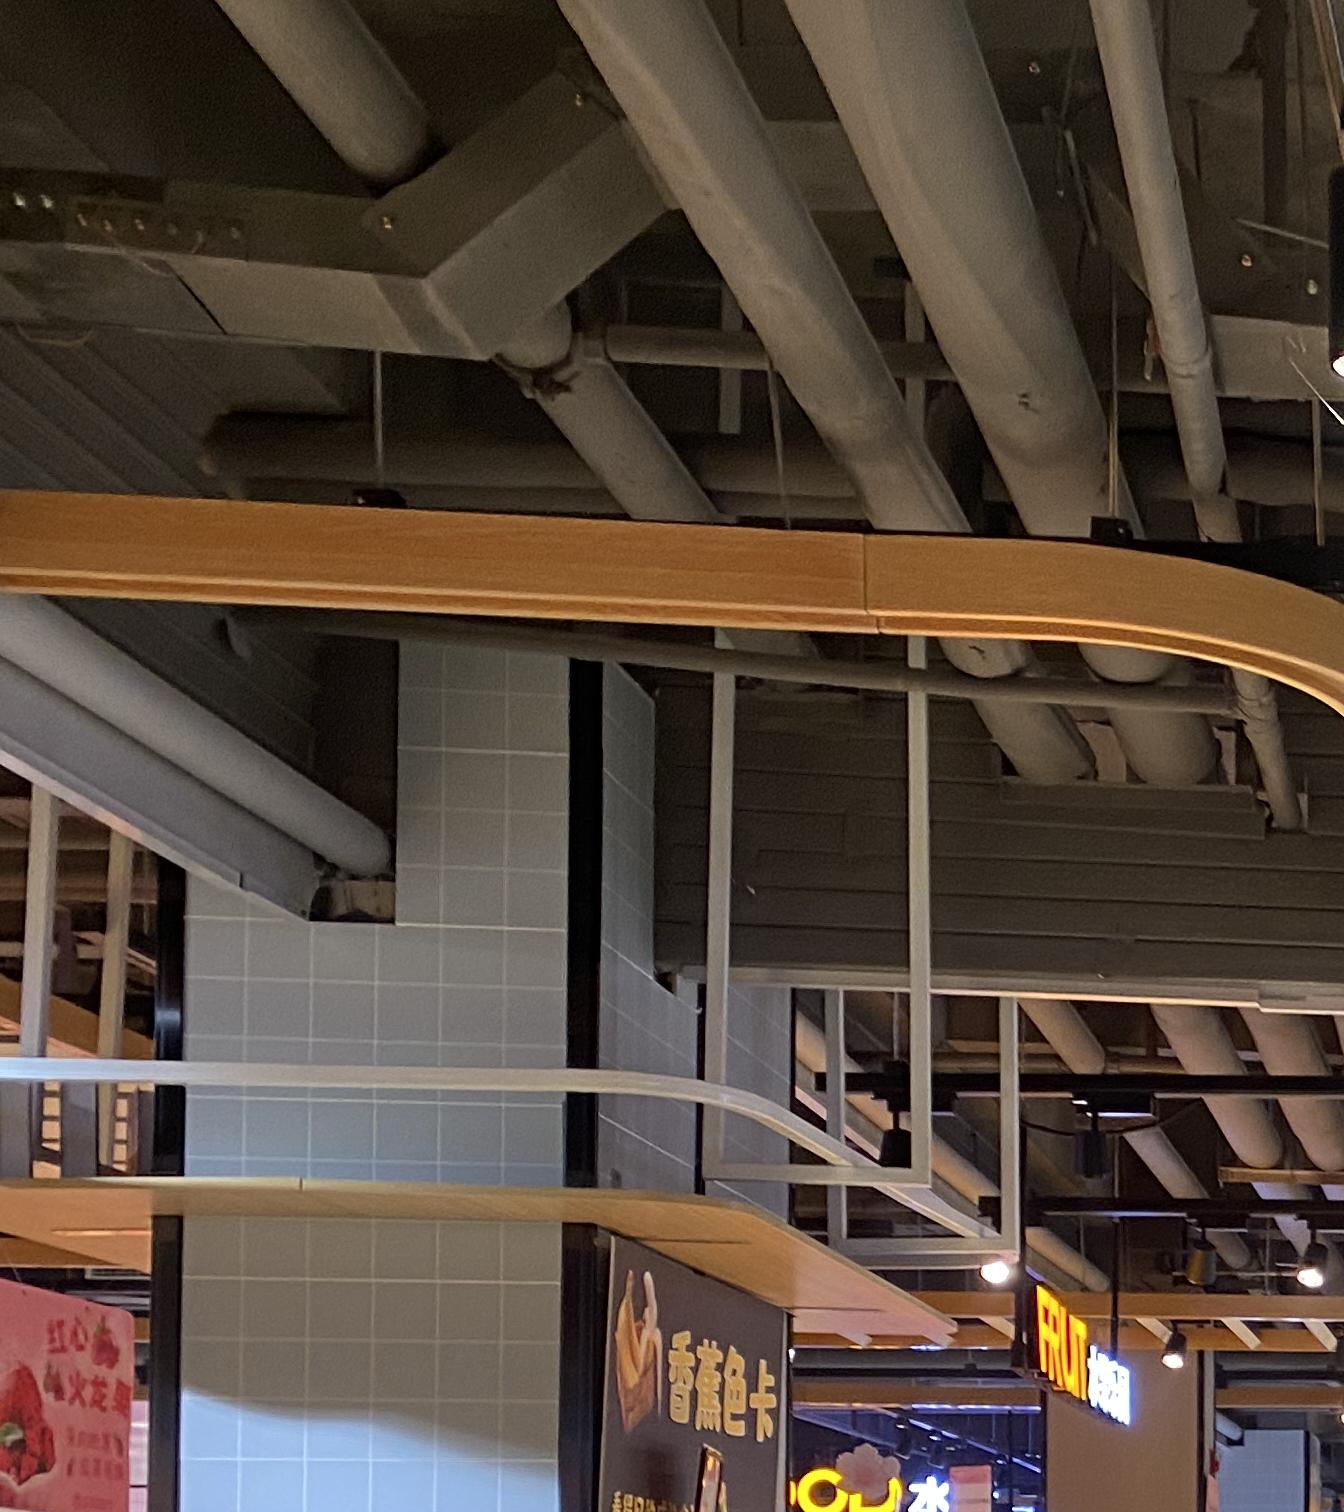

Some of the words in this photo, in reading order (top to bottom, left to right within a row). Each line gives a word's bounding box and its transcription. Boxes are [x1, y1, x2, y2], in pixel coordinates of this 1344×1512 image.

[669, 1330, 777, 1442] 香蕉色卡
[1036, 1284, 1088, 1401] FRUIT
